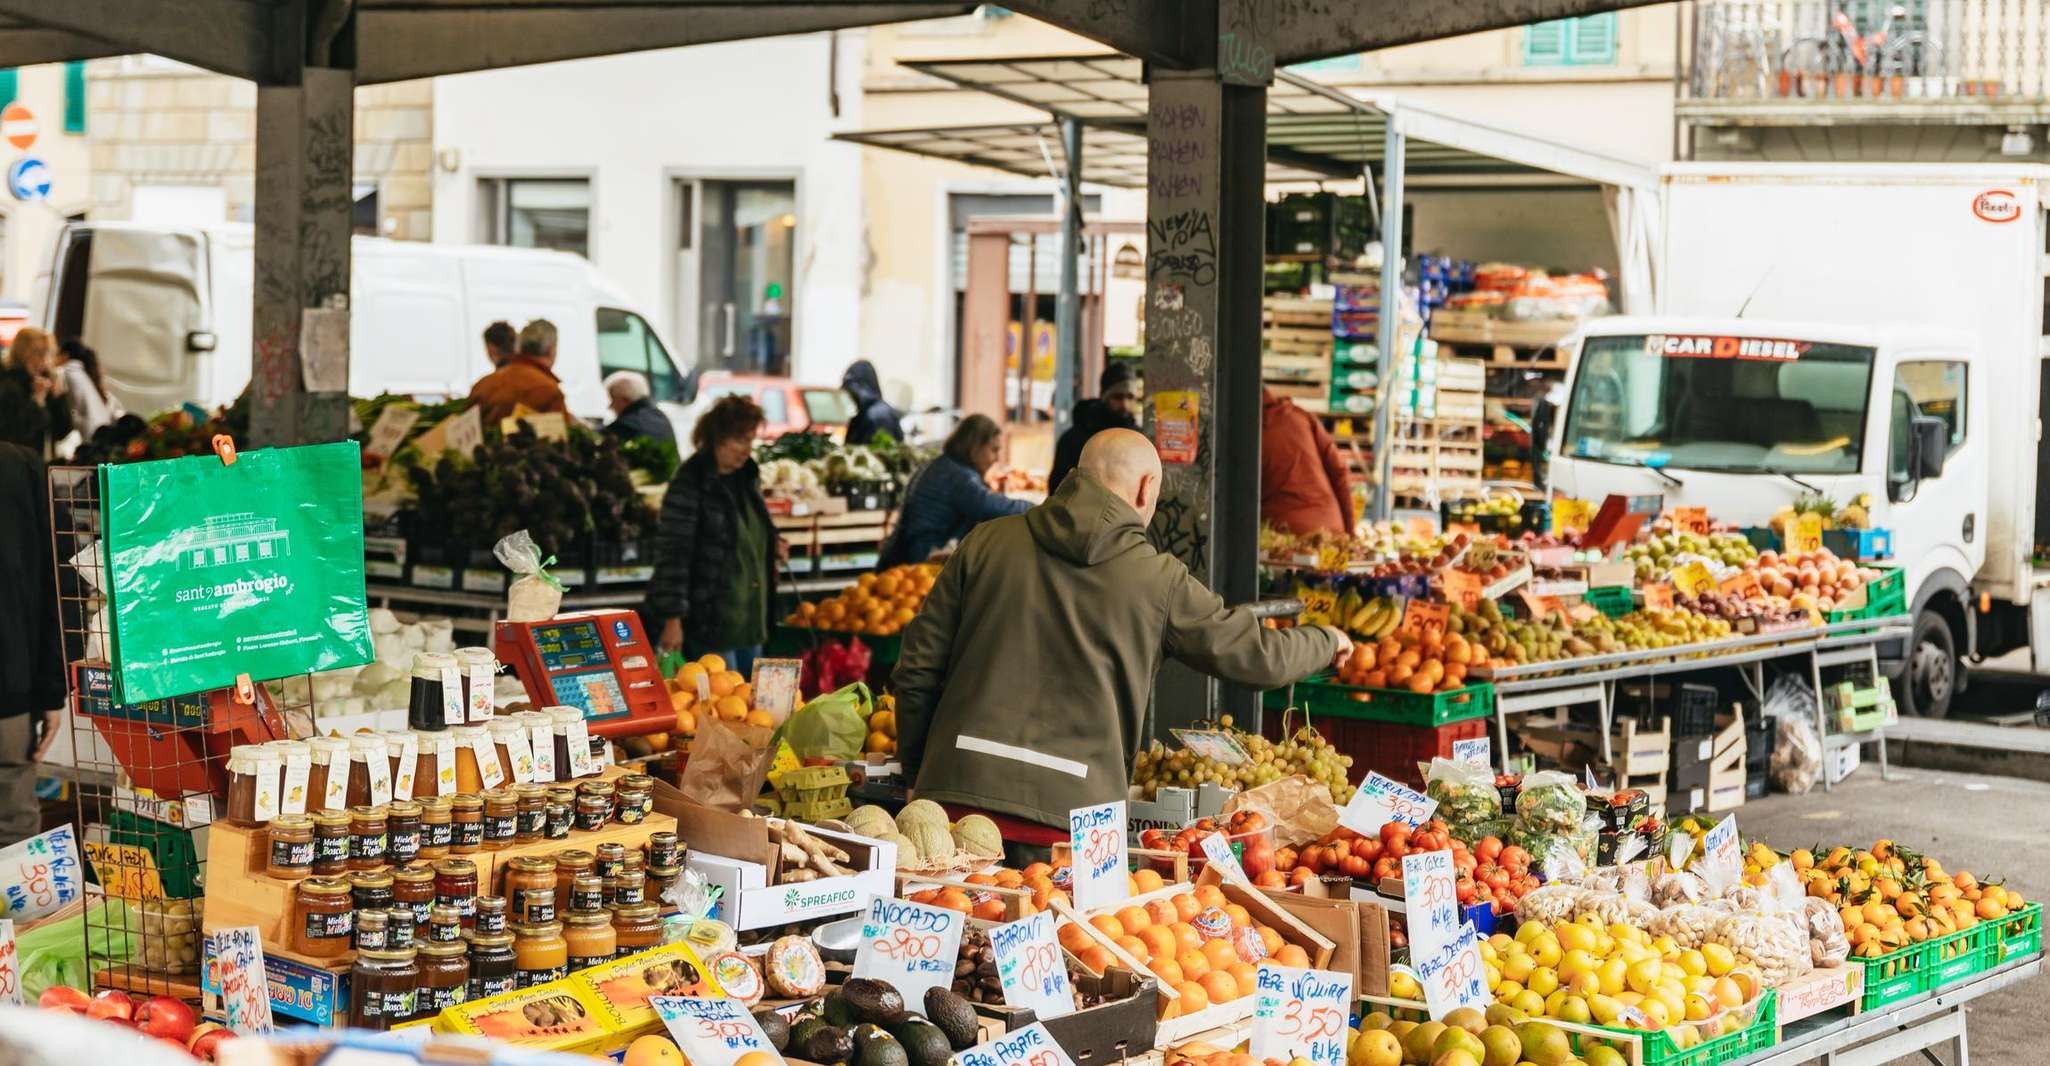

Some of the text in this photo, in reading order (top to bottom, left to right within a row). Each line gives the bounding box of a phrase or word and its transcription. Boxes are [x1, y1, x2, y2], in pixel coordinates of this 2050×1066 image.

[801, 889, 856, 909] SPREAFICO
[872, 898, 950, 932] AVOCADO
[1277, 1000, 1344, 1044] 3,50
